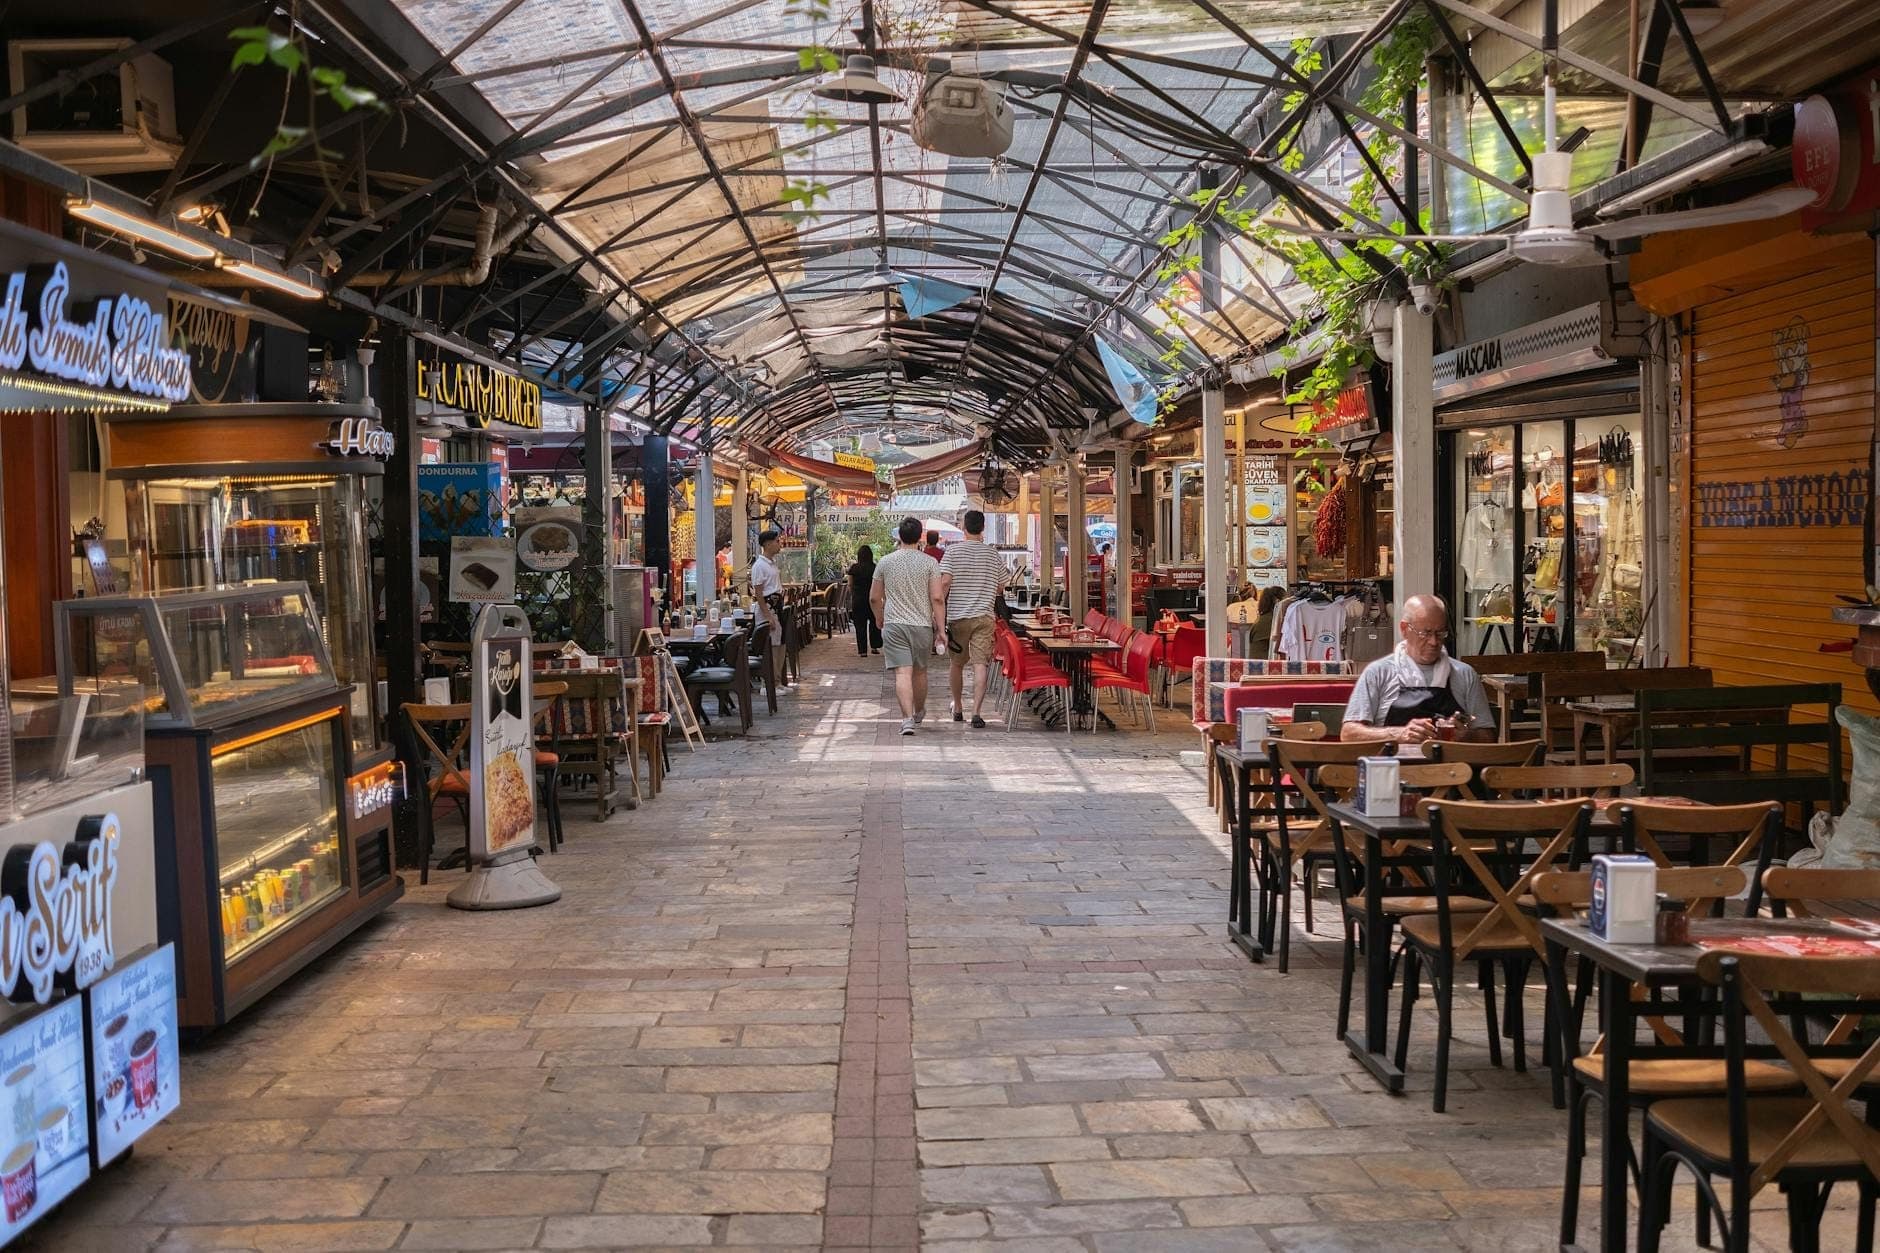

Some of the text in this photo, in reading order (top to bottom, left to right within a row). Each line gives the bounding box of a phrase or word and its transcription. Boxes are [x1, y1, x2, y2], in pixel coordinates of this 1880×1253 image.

[1455, 339, 1503, 380] MASCARA
[494, 368, 542, 428] BURGER
[418, 467, 478, 476] DONDURMA
[1245, 460, 1274, 469] TARİHİ
[78, 949, 102, 978] 1938
